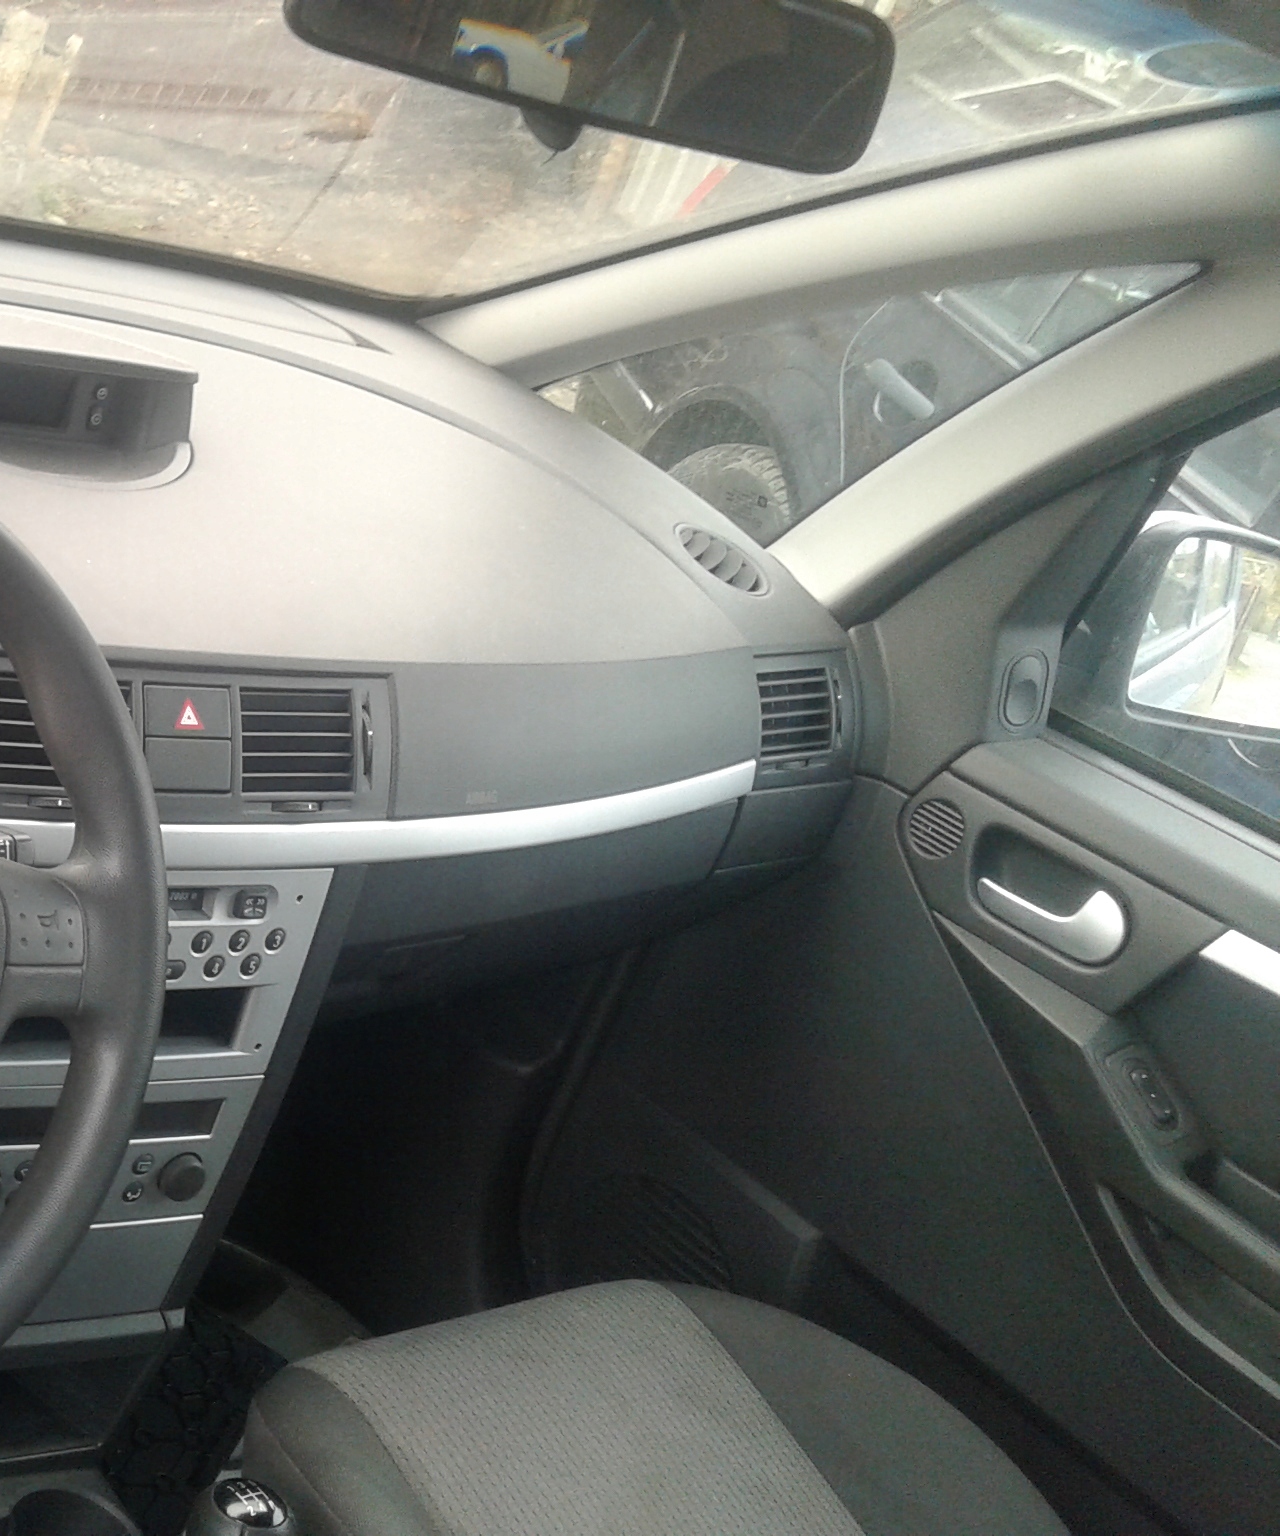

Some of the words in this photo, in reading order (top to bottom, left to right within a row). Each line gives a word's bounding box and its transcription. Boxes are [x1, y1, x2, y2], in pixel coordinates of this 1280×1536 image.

[201, 938, 208, 951] 1
[236, 937, 246, 950] 2
[272, 934, 282, 948] 3
[211, 962, 220, 975] 4
[248, 961, 257, 974] 5
